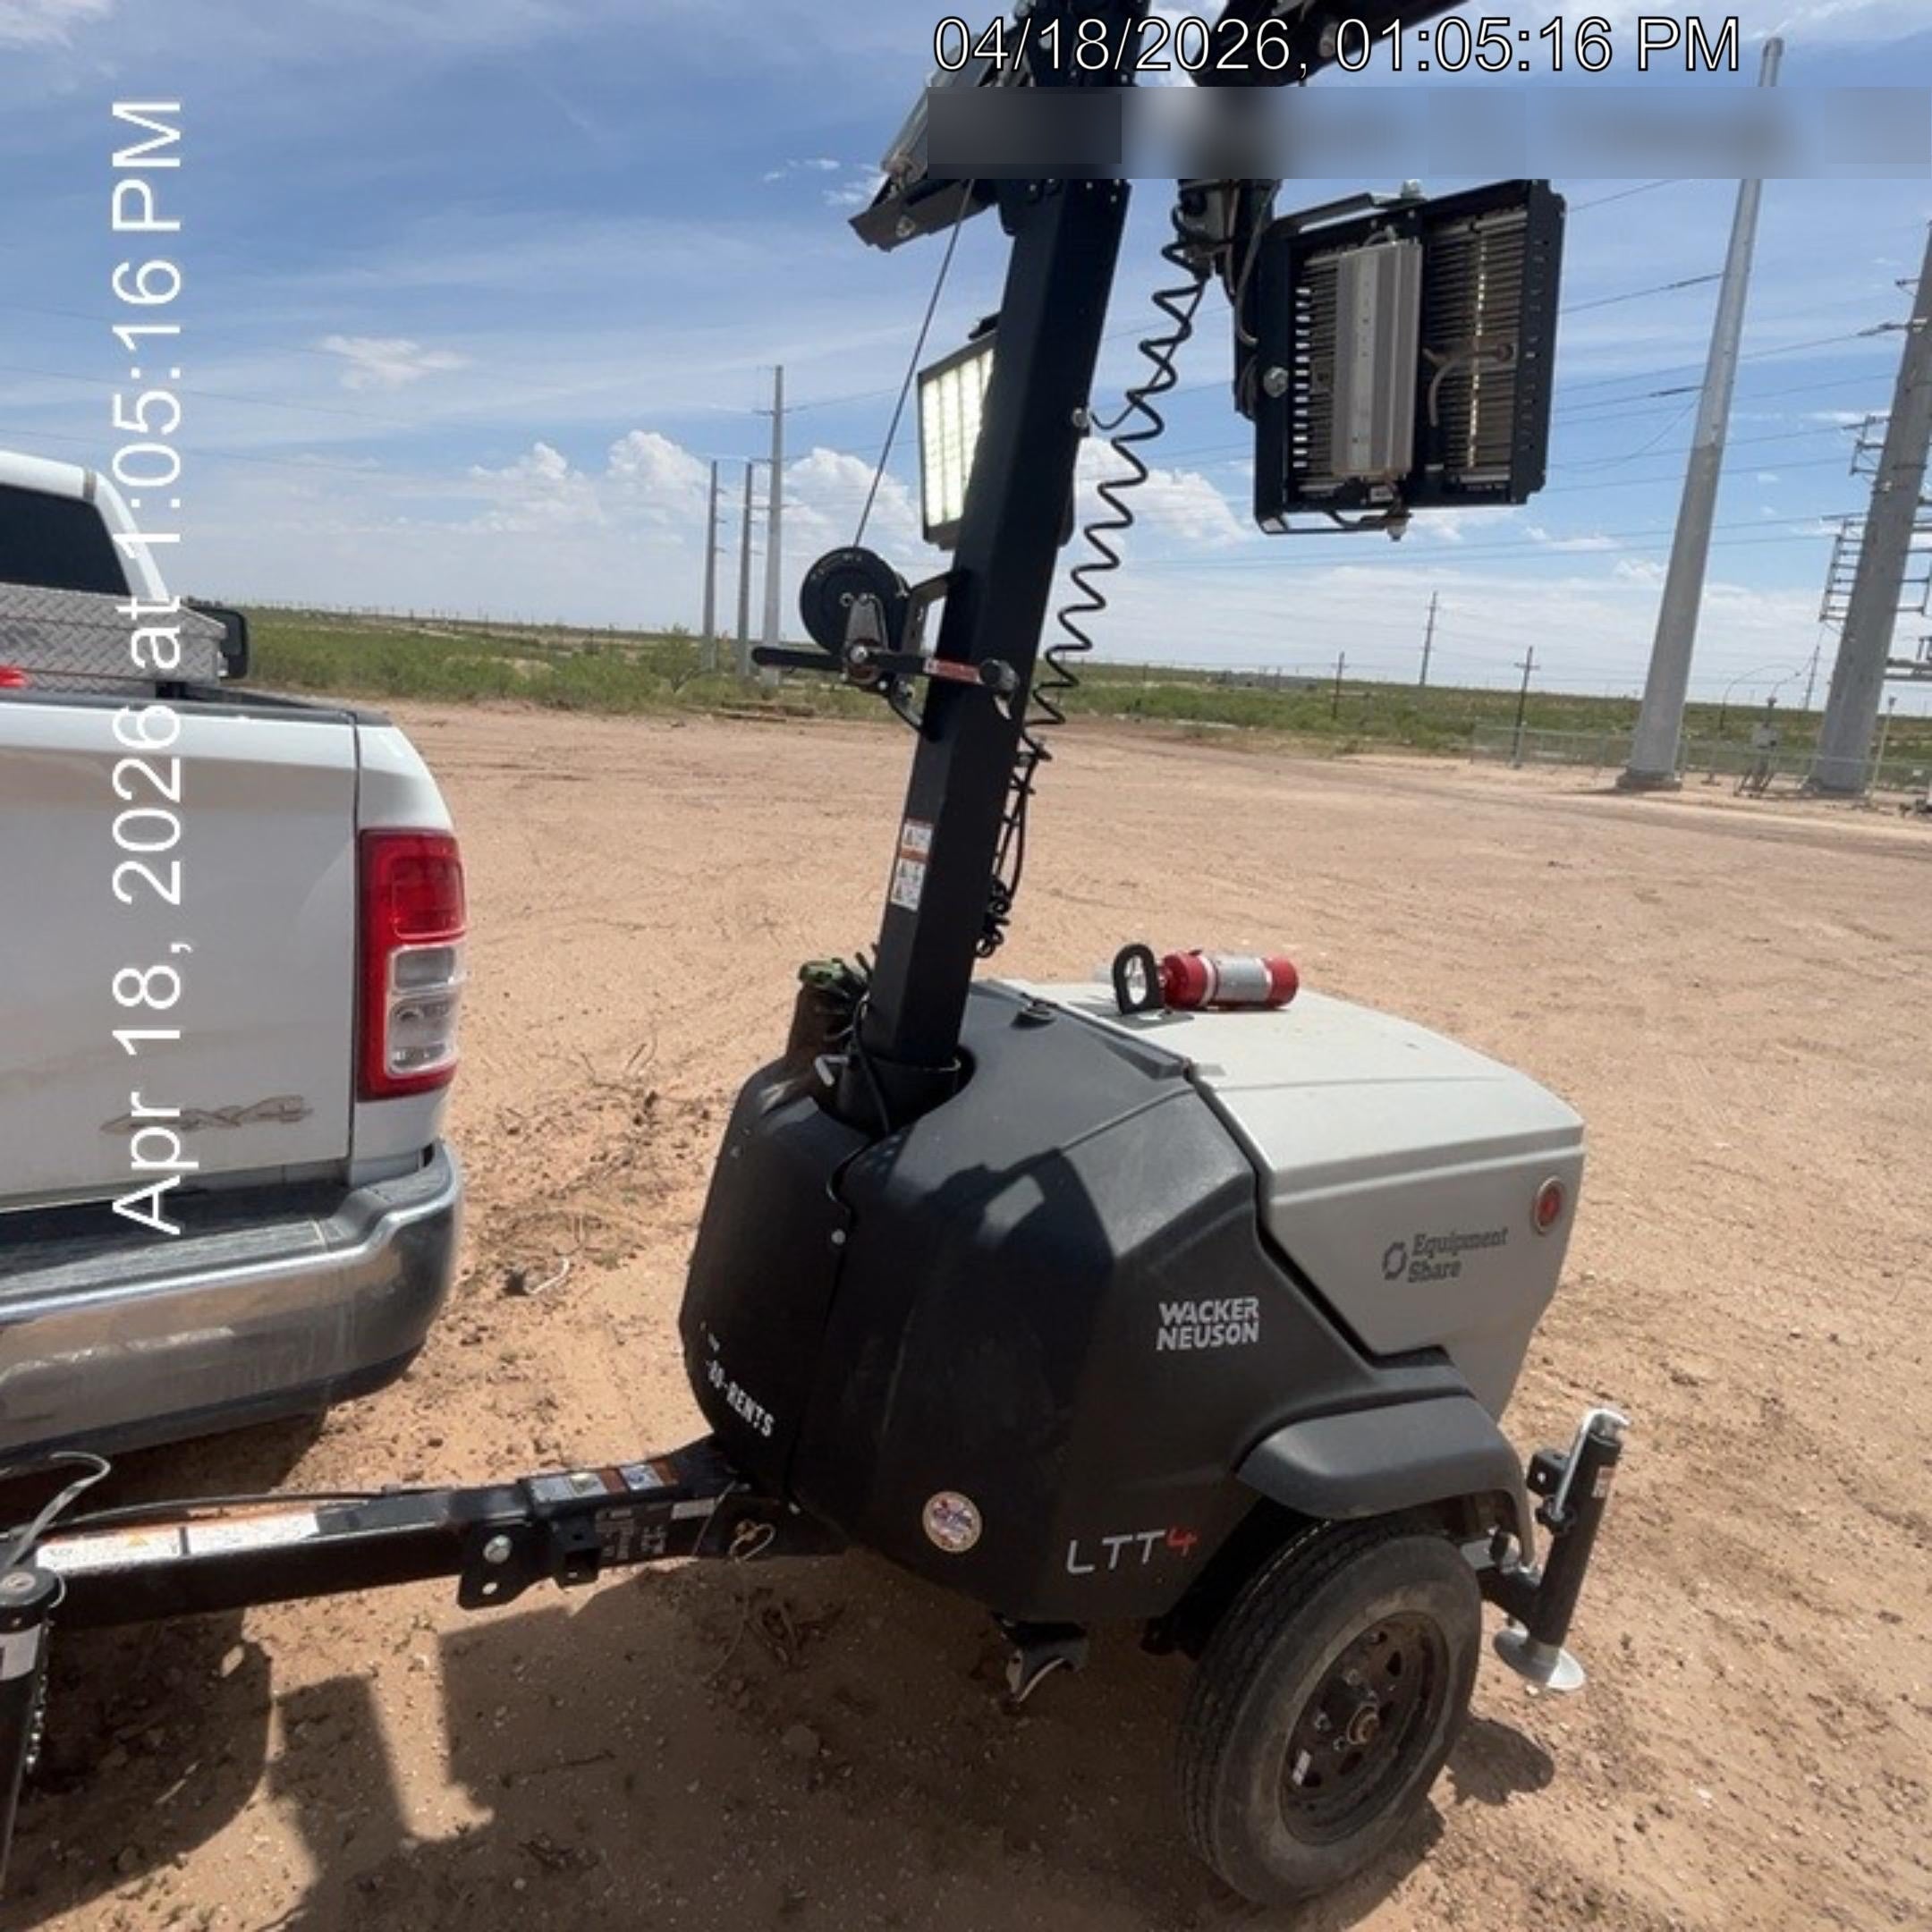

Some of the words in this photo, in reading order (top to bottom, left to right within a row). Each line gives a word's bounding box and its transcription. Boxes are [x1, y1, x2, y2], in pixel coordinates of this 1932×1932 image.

[1411, 1226, 1509, 1258] Equipment
[1407, 1260, 1462, 1284] Share
[1158, 1297, 1259, 1326] WACKER
[1156, 1322, 1259, 1351] NEUSON
[1067, 1528, 1198, 1574] LTT4
